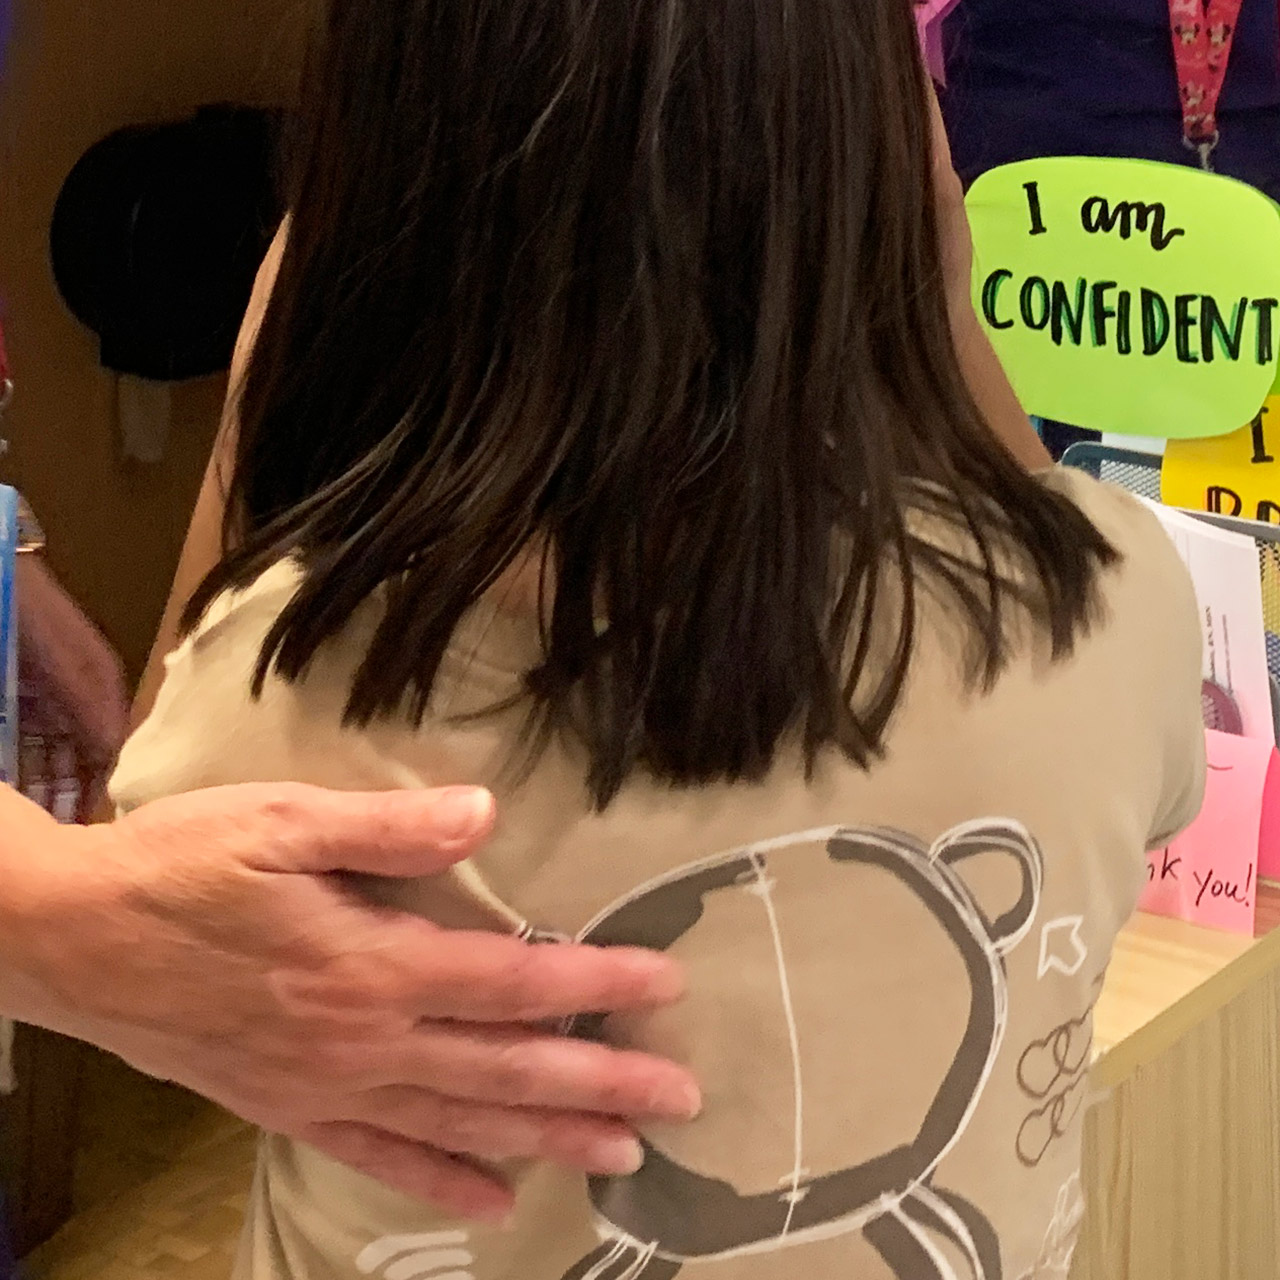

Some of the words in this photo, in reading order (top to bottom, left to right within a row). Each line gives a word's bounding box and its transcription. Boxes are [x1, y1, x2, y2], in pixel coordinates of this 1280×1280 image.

[1022, 180, 1047, 236] I
[1080, 195, 1185, 251] am
[981, 268, 1279, 366] CONFIDENT
[1250, 406, 1274, 464] I
